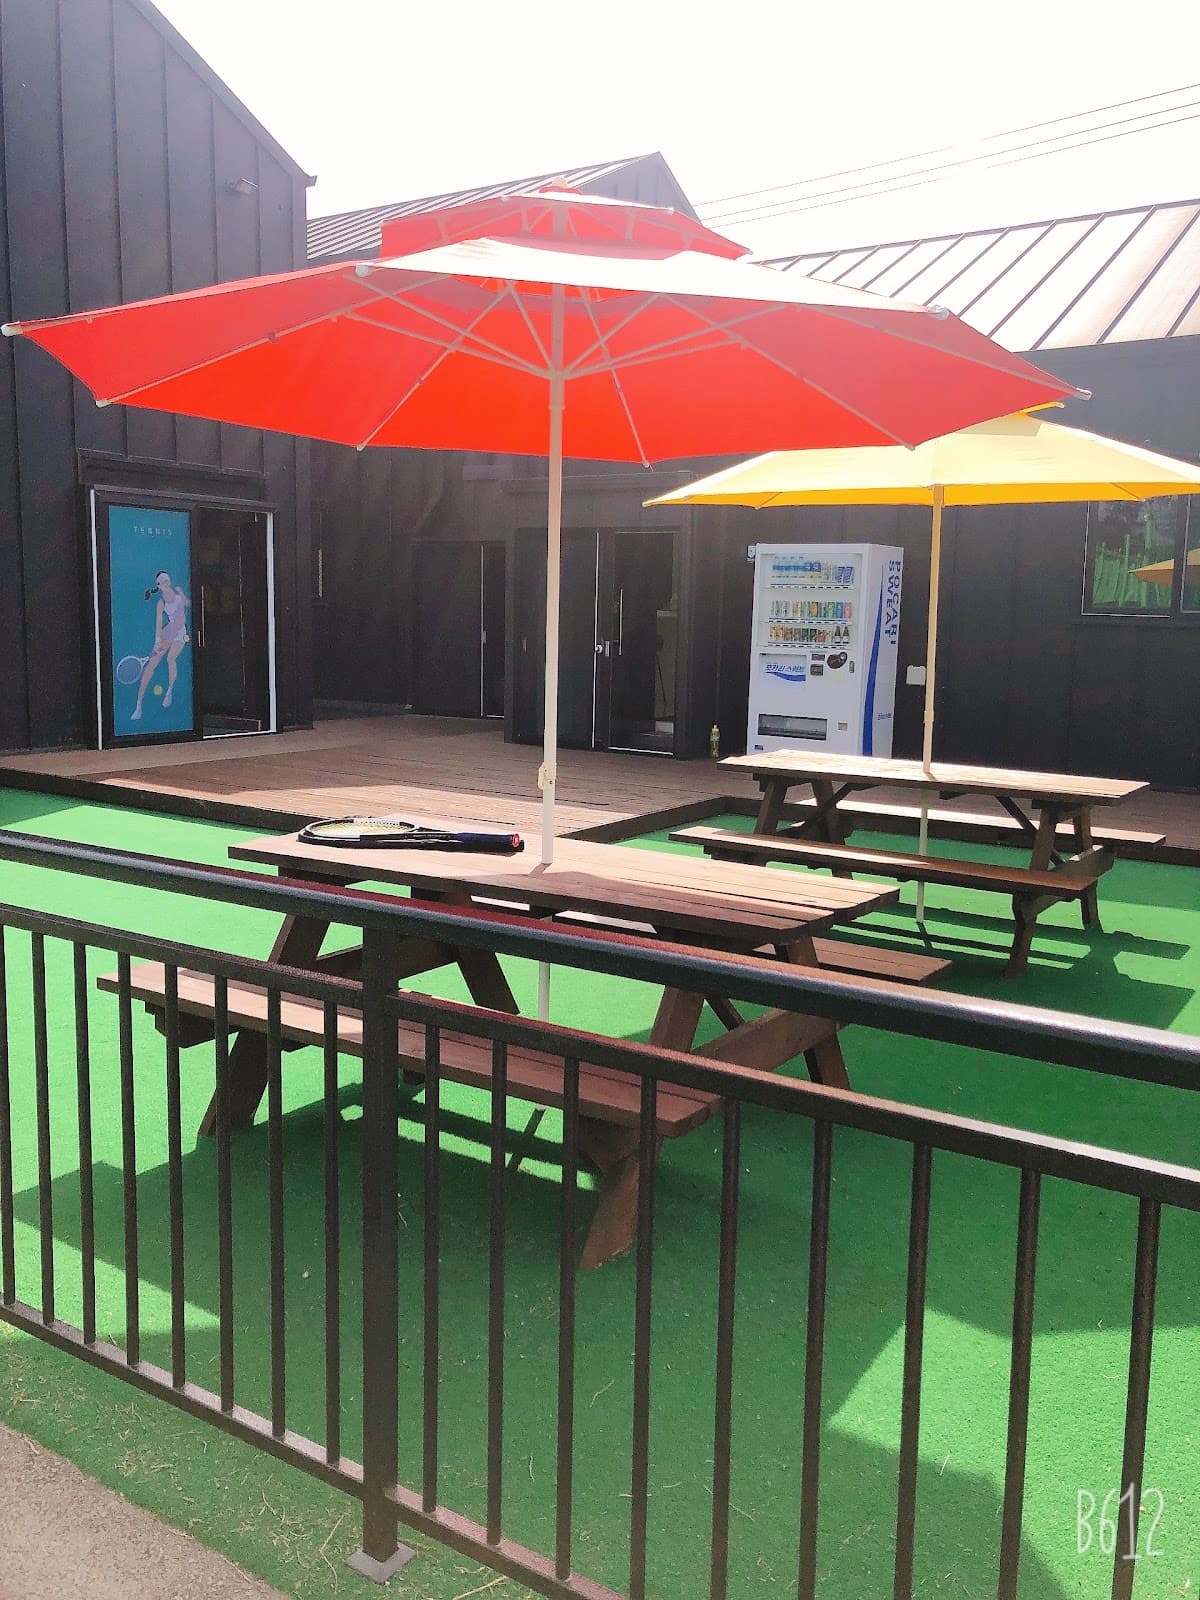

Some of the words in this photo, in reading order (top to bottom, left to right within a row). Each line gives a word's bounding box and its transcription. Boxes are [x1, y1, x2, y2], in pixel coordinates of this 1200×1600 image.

[132, 525, 173, 536] TENNIS
[884, 560, 896, 637] SWEAT
[890, 560, 902, 645] POCARI
